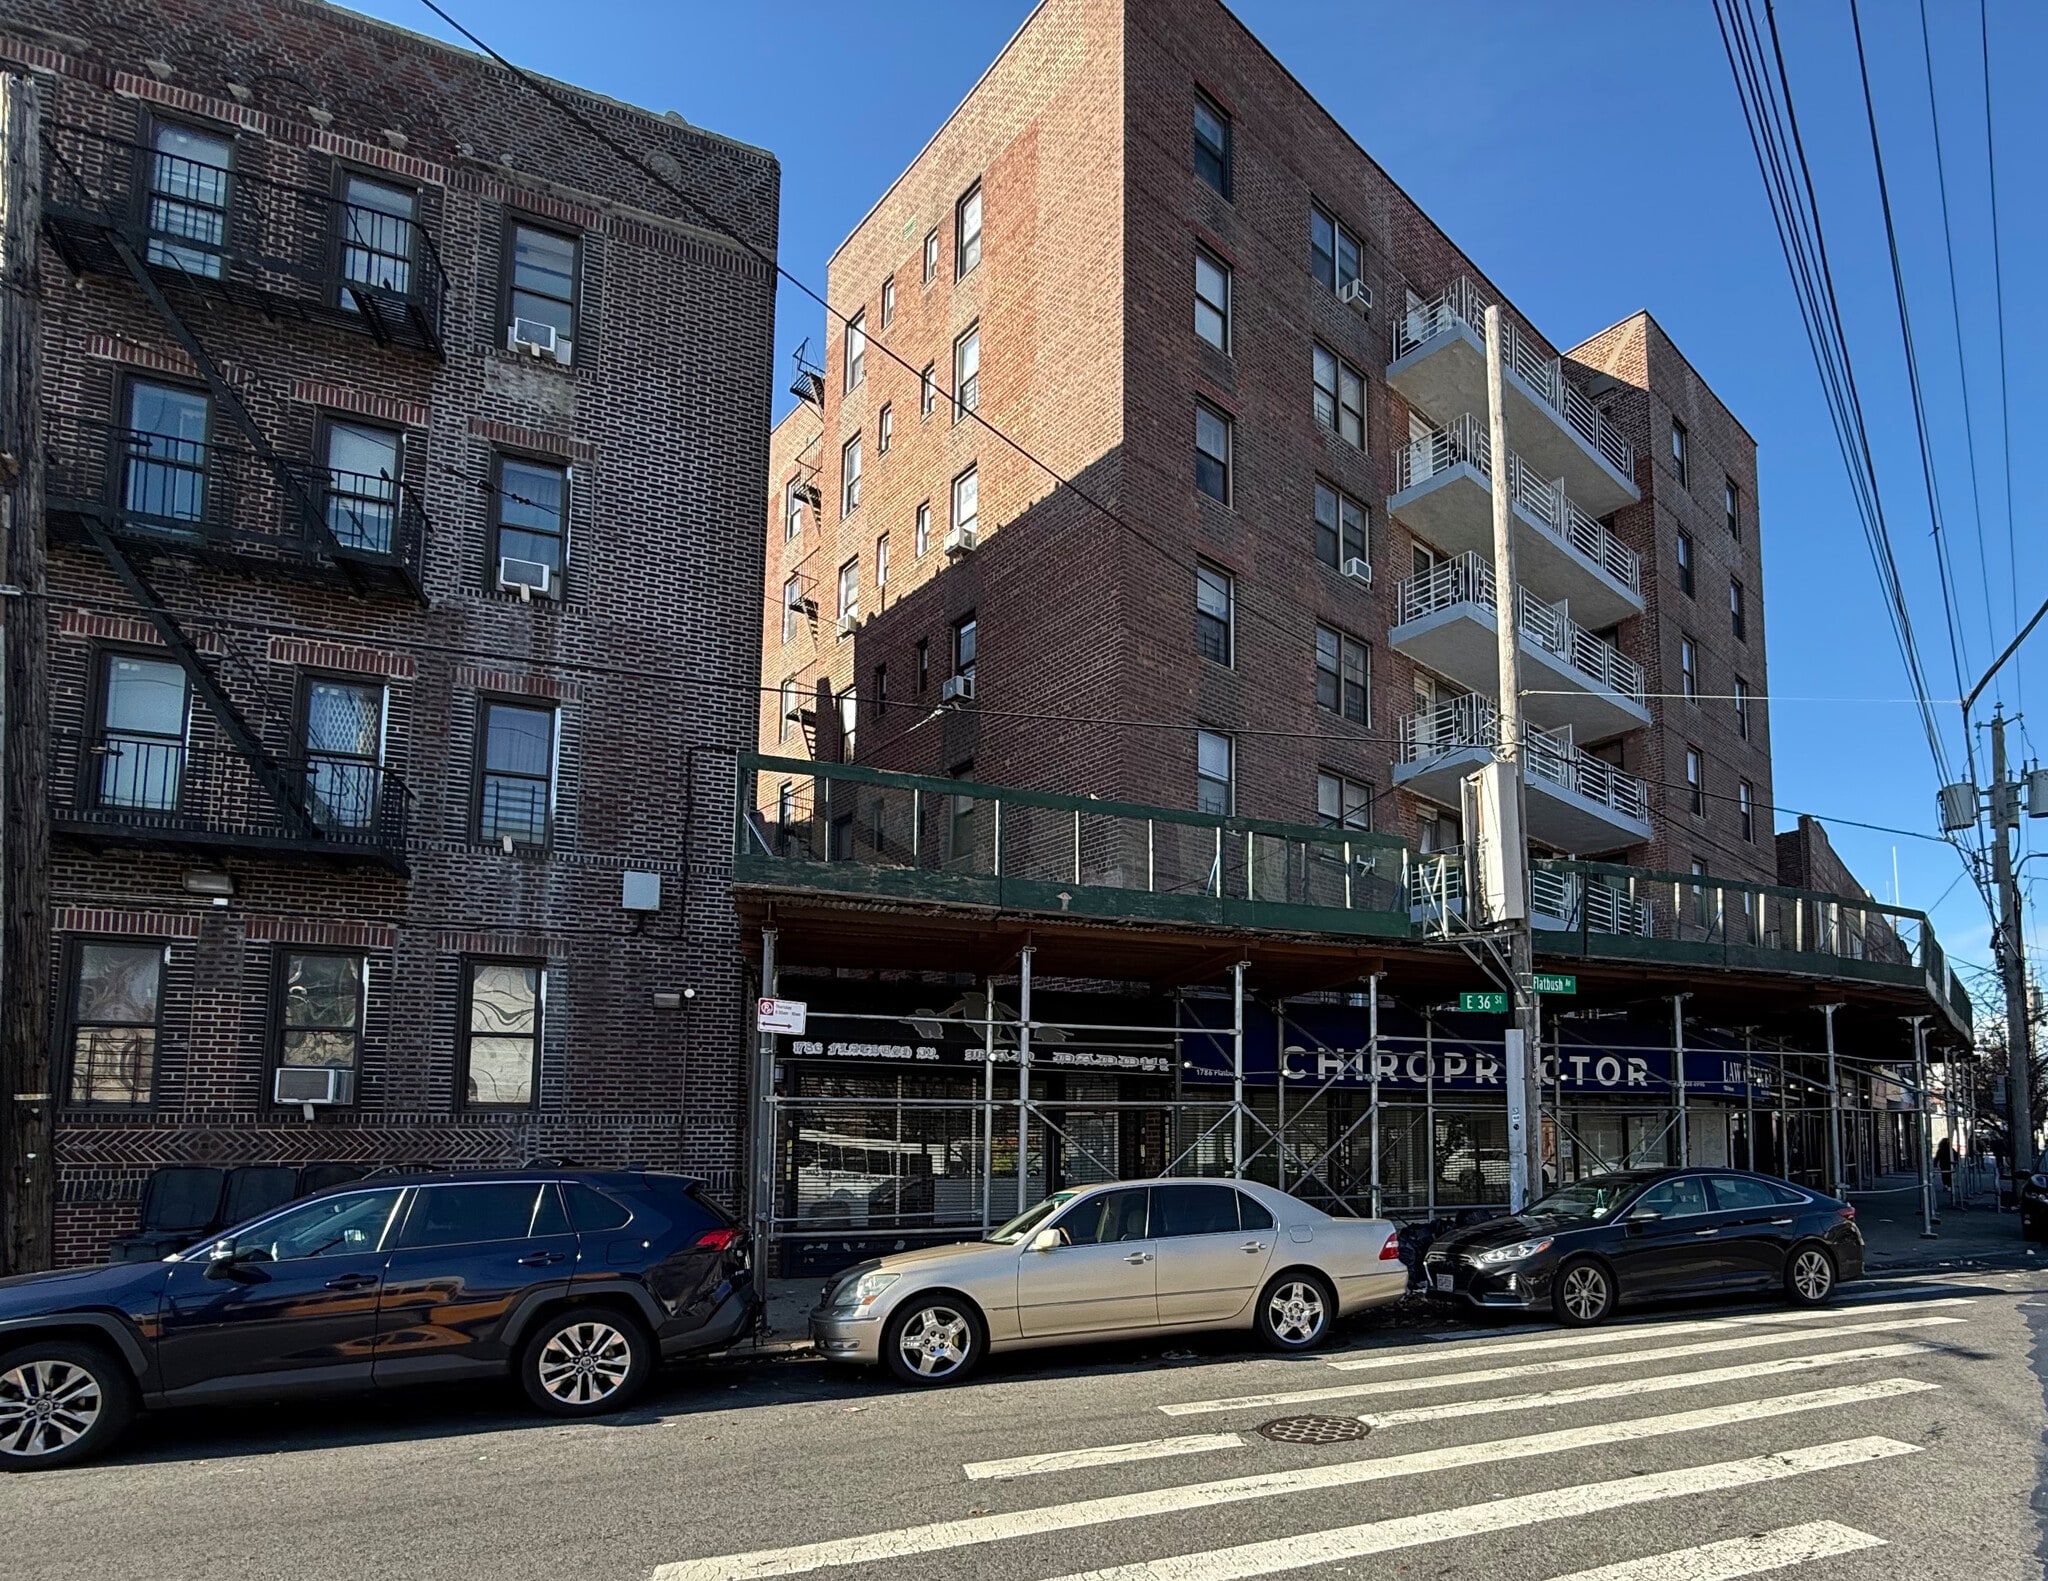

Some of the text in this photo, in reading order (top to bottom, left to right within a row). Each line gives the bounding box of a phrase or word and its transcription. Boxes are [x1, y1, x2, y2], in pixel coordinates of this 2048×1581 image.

[1533, 976, 1563, 991] Flatbush
[1466, 994, 1502, 1010] E 36 St
[793, 1041, 823, 1055] 1786
[1283, 1045, 1649, 1087] CHIROPRCTOR
[1722, 1060, 1742, 1084] LAW
